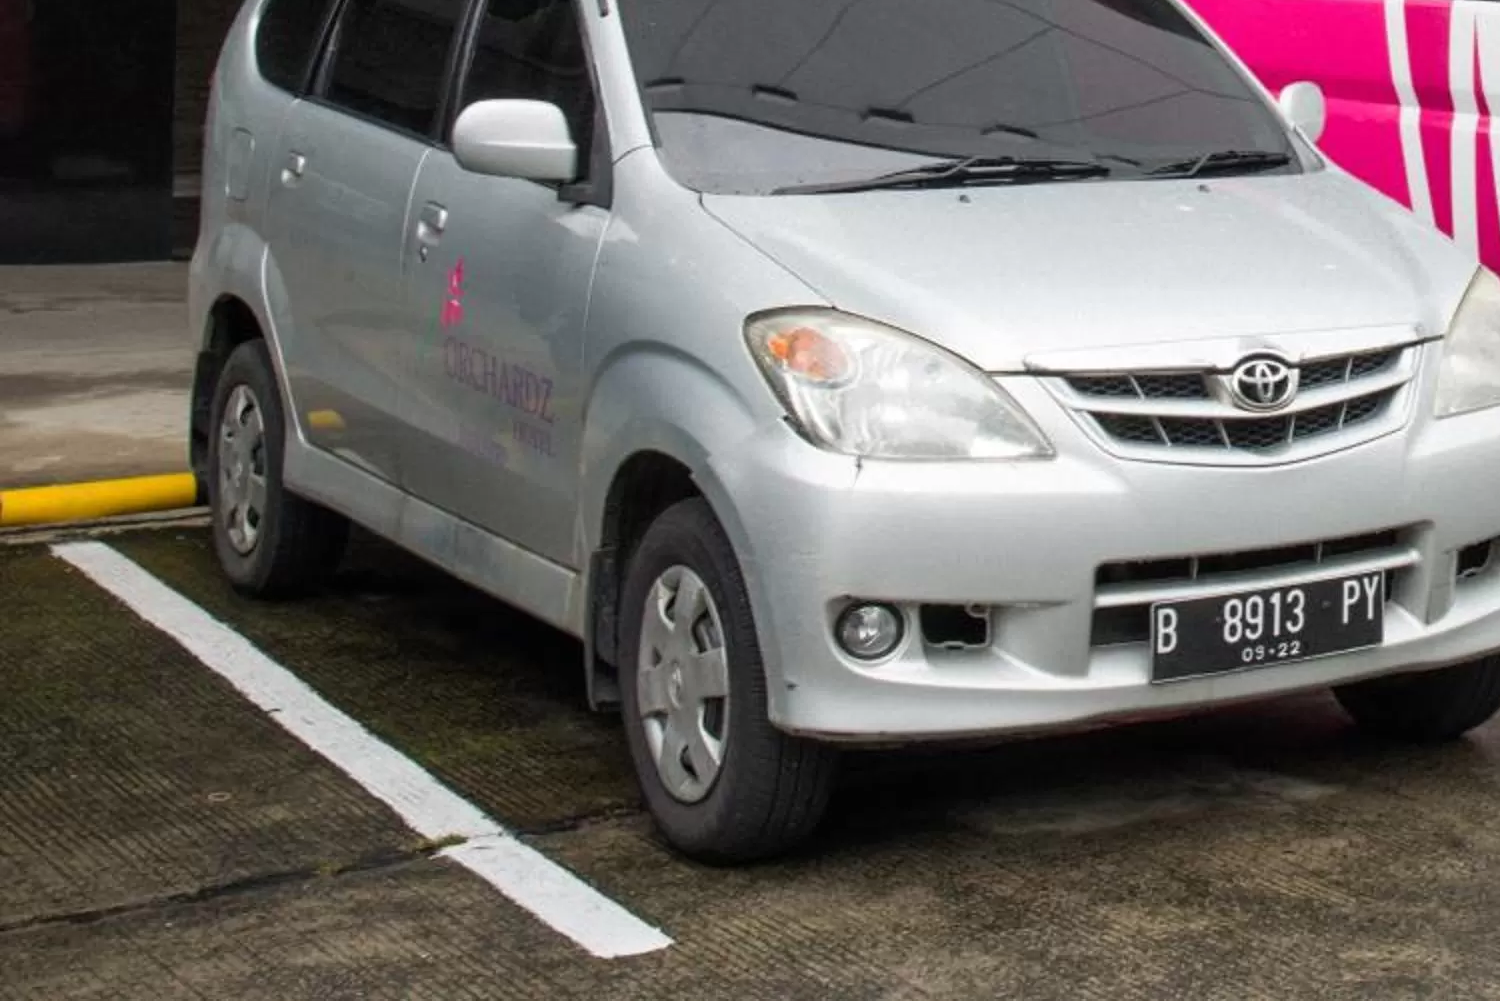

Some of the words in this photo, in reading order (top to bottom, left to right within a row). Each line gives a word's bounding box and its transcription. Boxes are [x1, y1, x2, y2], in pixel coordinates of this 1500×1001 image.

[444, 336, 556, 424] ORCHARDZ
[1156, 608, 1178, 654] B
[1223, 589, 1306, 643] 8913
[1342, 575, 1380, 625] PY
